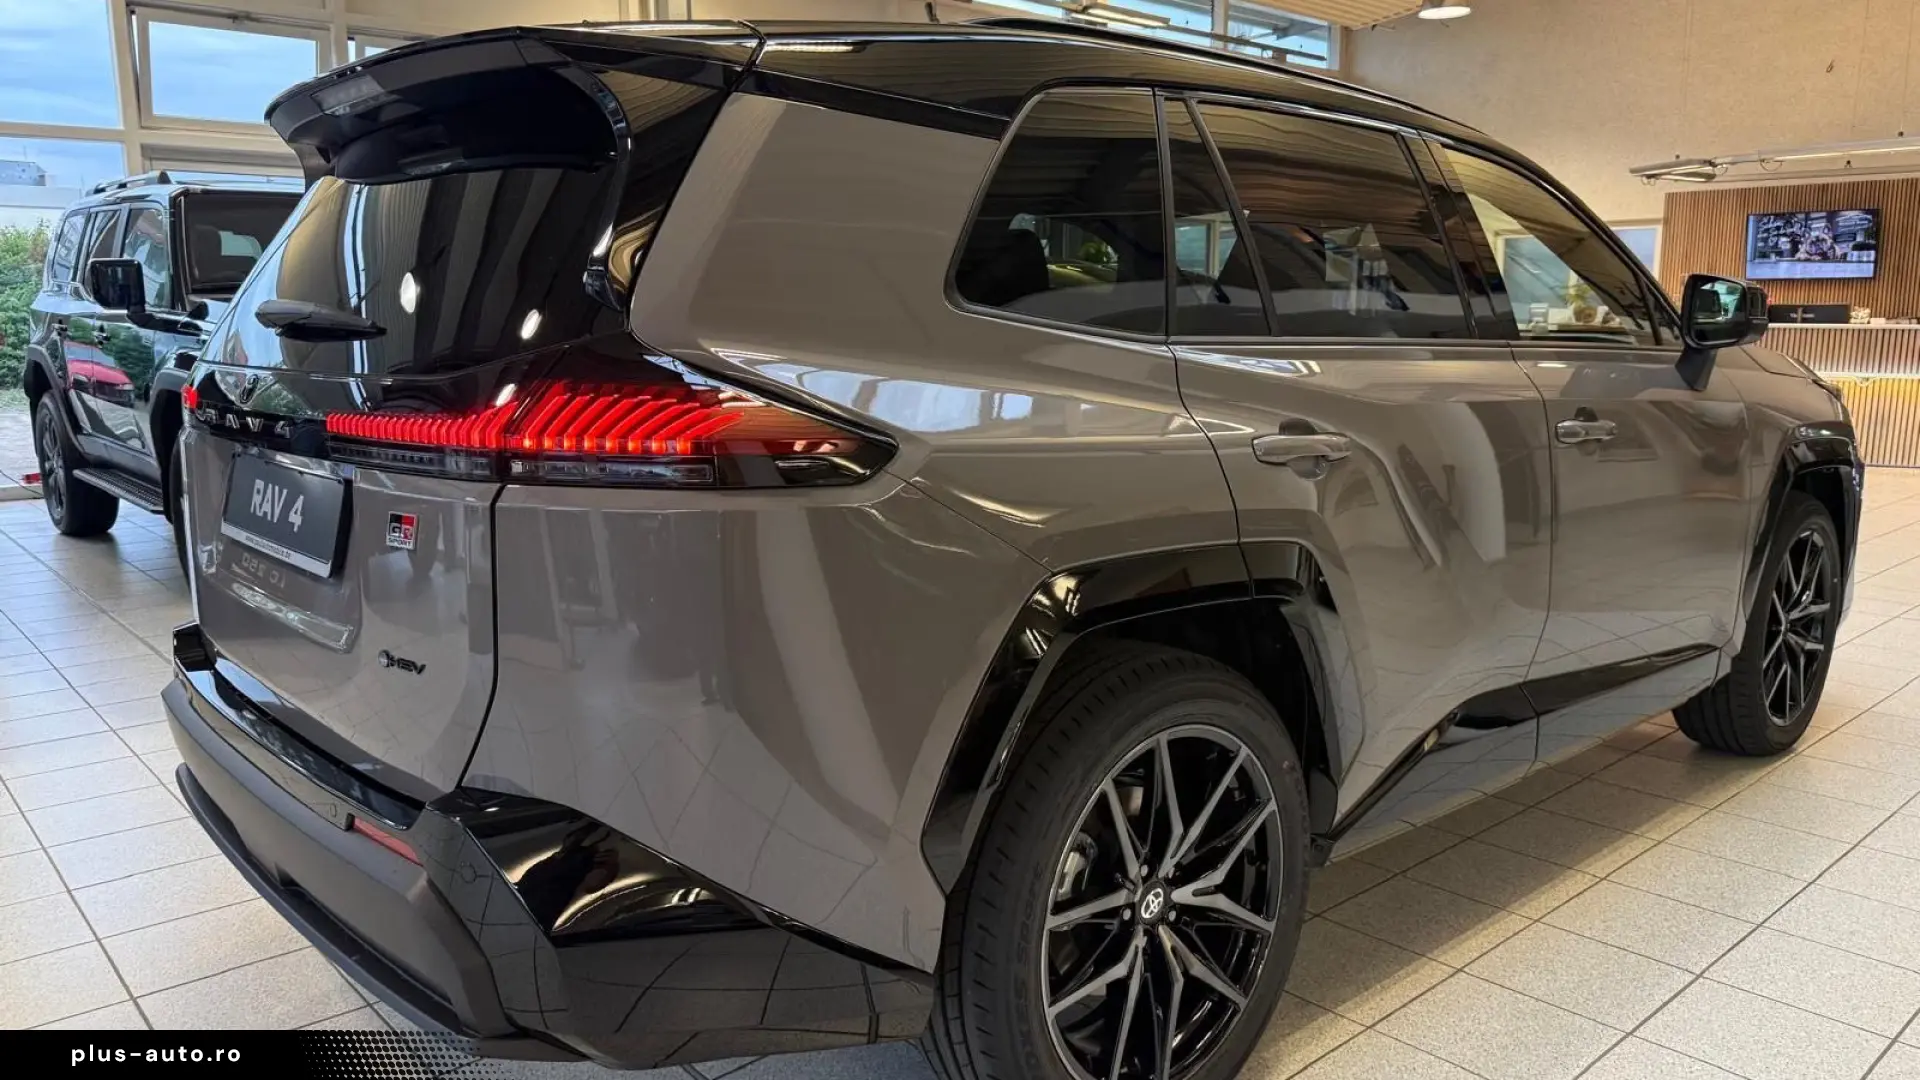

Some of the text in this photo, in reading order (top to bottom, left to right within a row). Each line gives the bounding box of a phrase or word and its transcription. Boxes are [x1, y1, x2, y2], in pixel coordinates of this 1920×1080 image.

[250, 479, 304, 533] RAV 4
[390, 523, 414, 541] GR
[388, 536, 413, 549] SPORT
